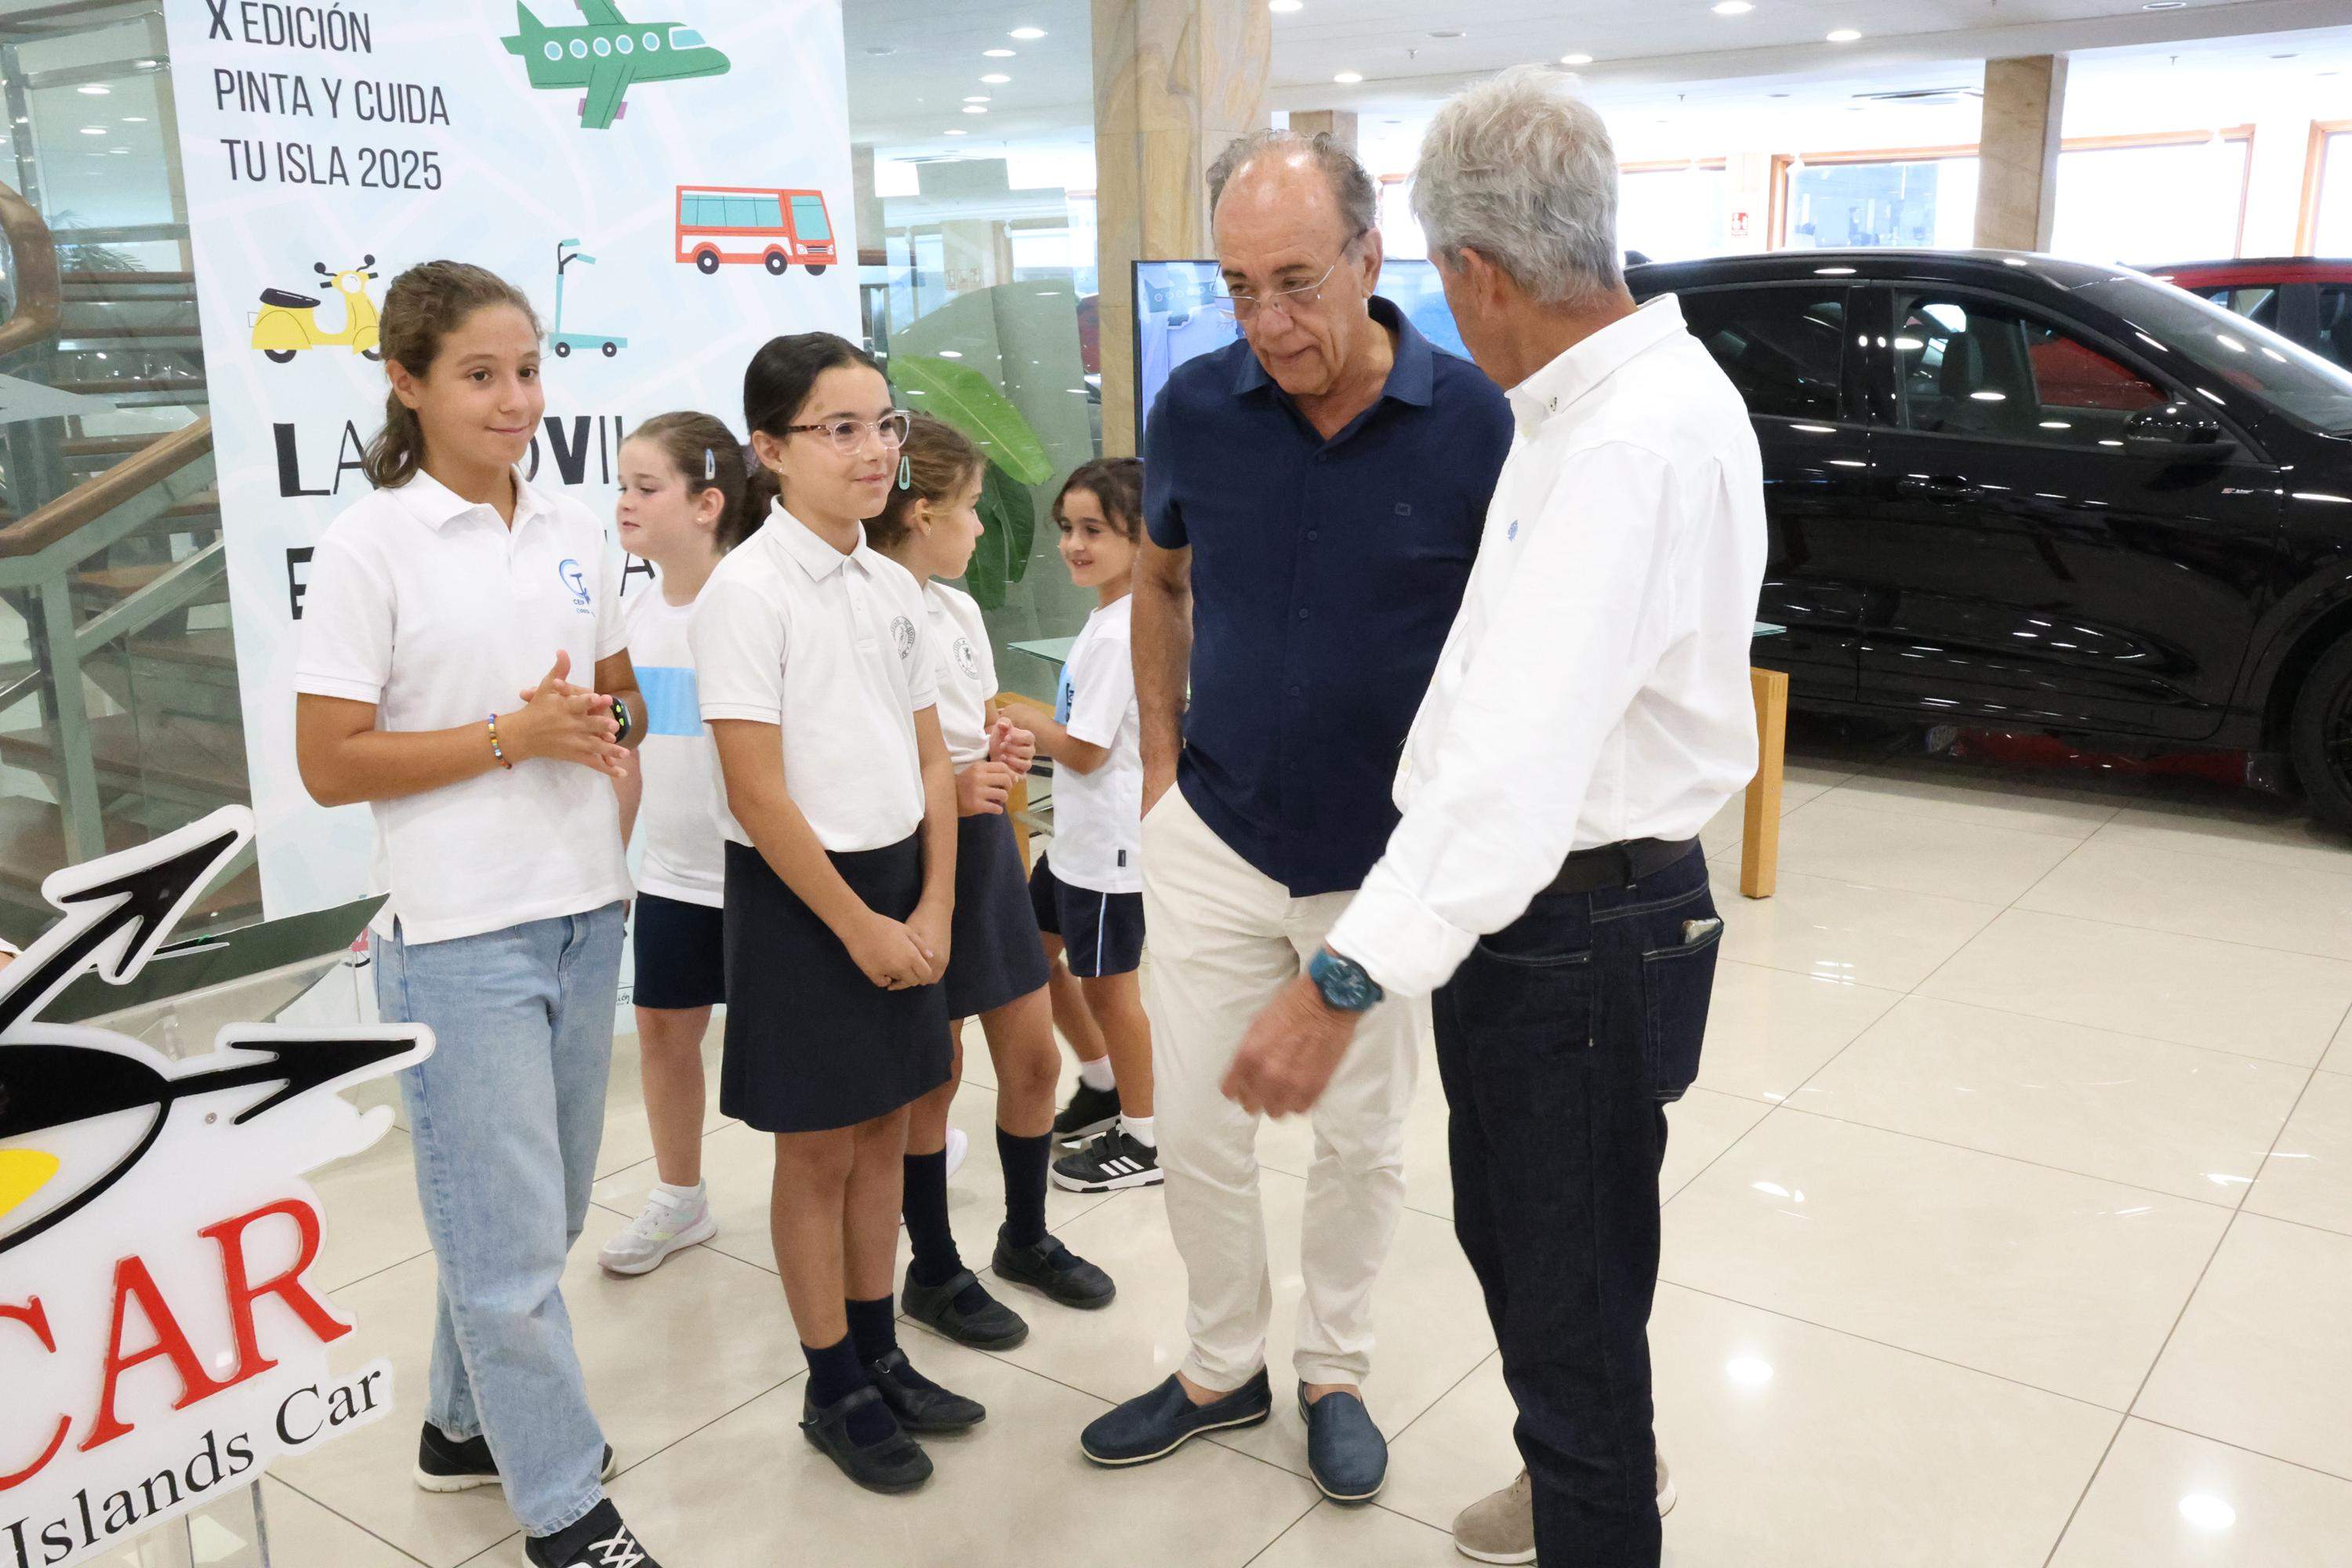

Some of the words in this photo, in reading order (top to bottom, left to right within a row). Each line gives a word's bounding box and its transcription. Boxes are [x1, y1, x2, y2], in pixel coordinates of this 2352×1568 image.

[206, 0, 233, 41] X
[241, 2, 372, 53] EDICIÓN
[214, 68, 314, 117] PINTA
[321, 77, 342, 118] Y
[354, 80, 450, 125] CUIDA
[220, 139, 267, 181] TU
[277, 142, 350, 186] ISLA
[358, 147, 441, 190] 2025
[2, 1429, 255, 1568] Islands
[274, 1370, 382, 1446] Car
